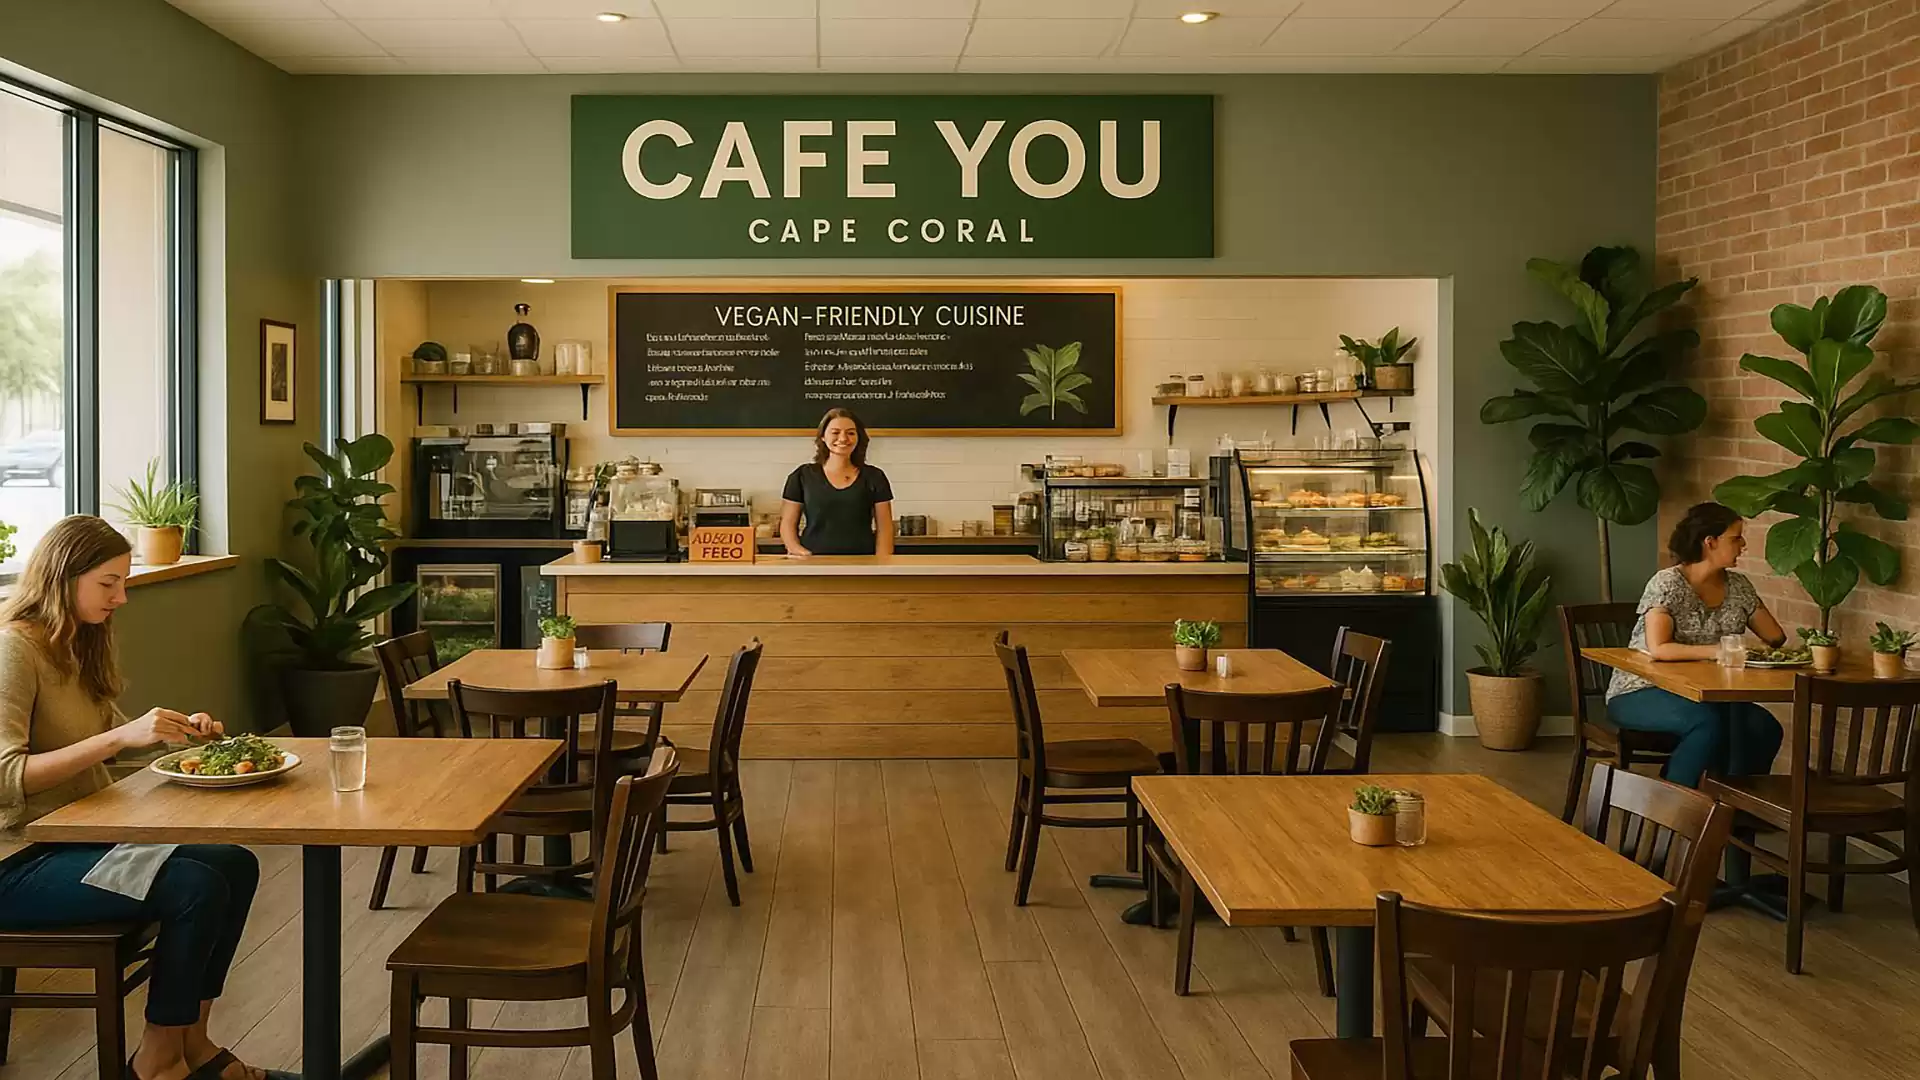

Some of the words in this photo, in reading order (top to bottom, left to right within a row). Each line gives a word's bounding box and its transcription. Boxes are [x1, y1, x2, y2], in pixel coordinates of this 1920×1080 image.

[622, 119, 897, 200] CAFE
[934, 119, 1161, 199] YOU
[748, 218, 857, 244] CAPE
[887, 218, 1034, 243] CORAL
[714, 305, 925, 327] VEGAN-FRIENDLY
[935, 305, 1025, 326] CUISINE
